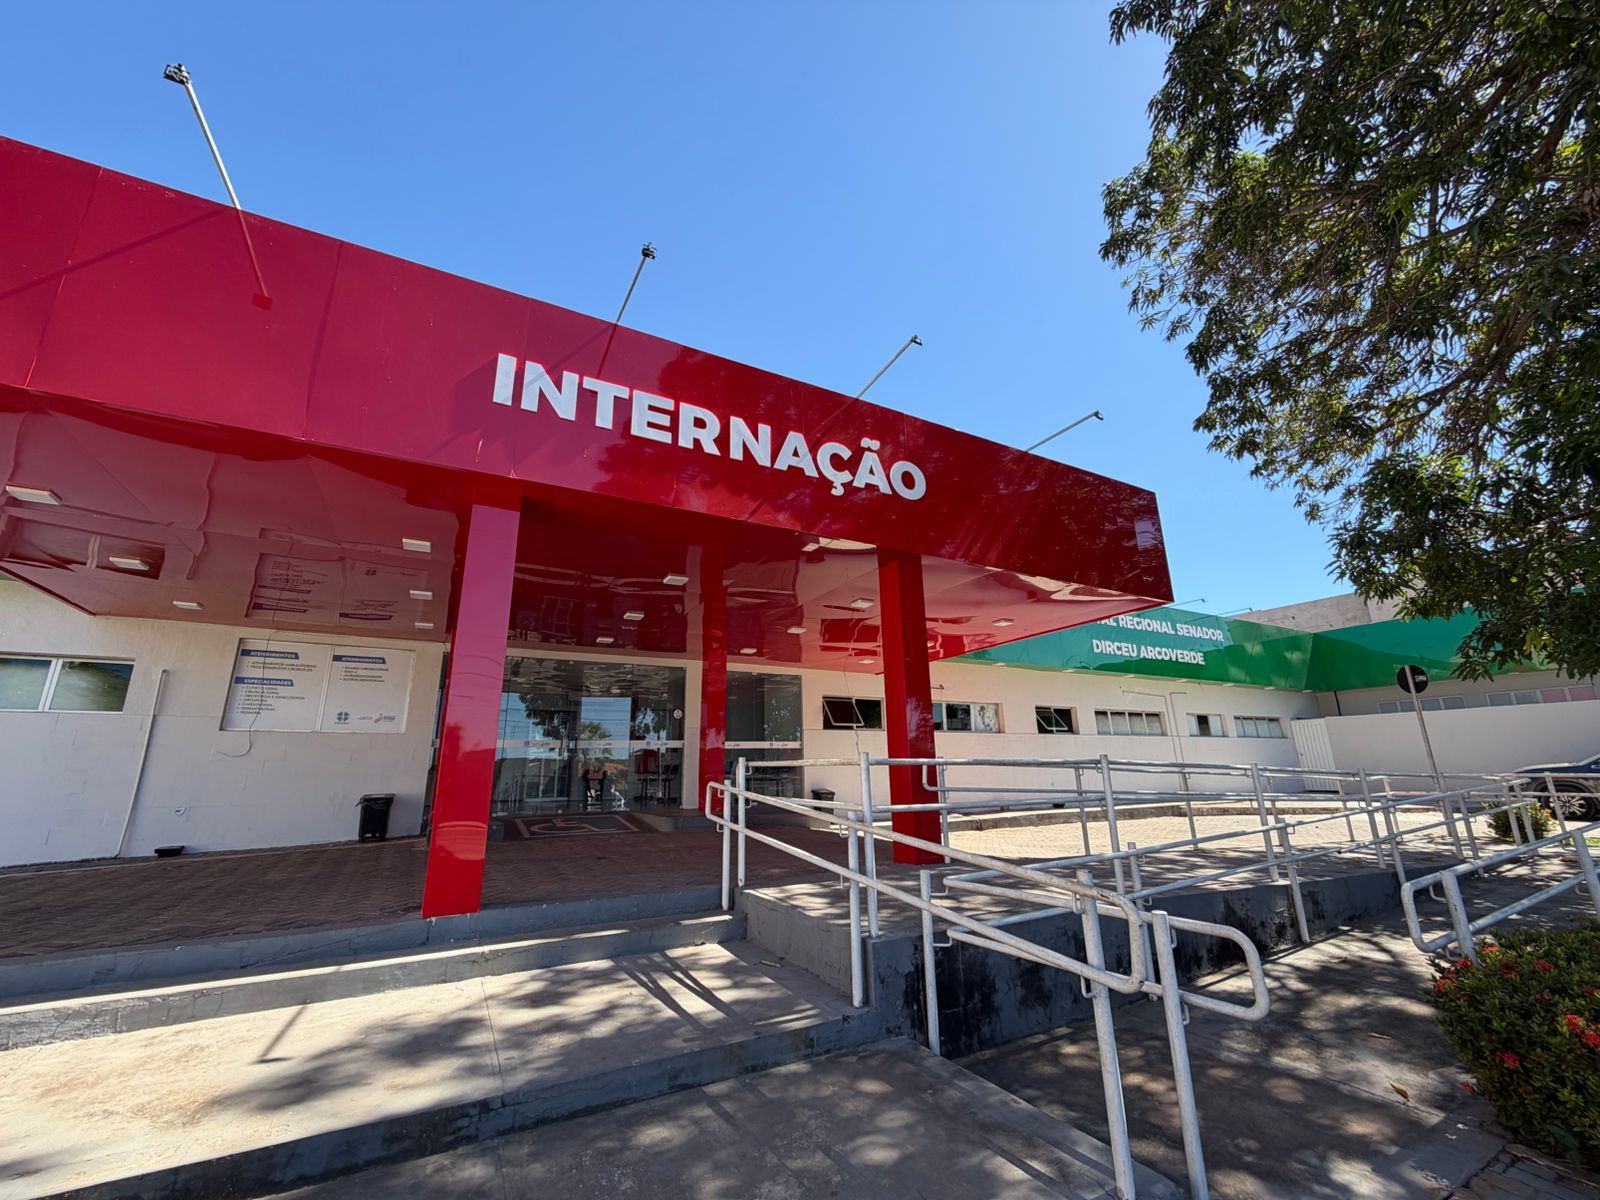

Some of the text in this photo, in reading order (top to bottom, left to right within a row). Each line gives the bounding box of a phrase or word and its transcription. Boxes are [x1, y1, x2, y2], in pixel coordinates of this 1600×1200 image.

[493, 353, 927, 501] INTERNAÇÃO
[1118, 615, 1176, 635] REGIONAL
[1176, 623, 1224, 642] SENADOR
[250, 651, 296, 659] ATENDIMENTOS
[1092, 639, 1205, 665] DIRCEU ARCOVERDE
